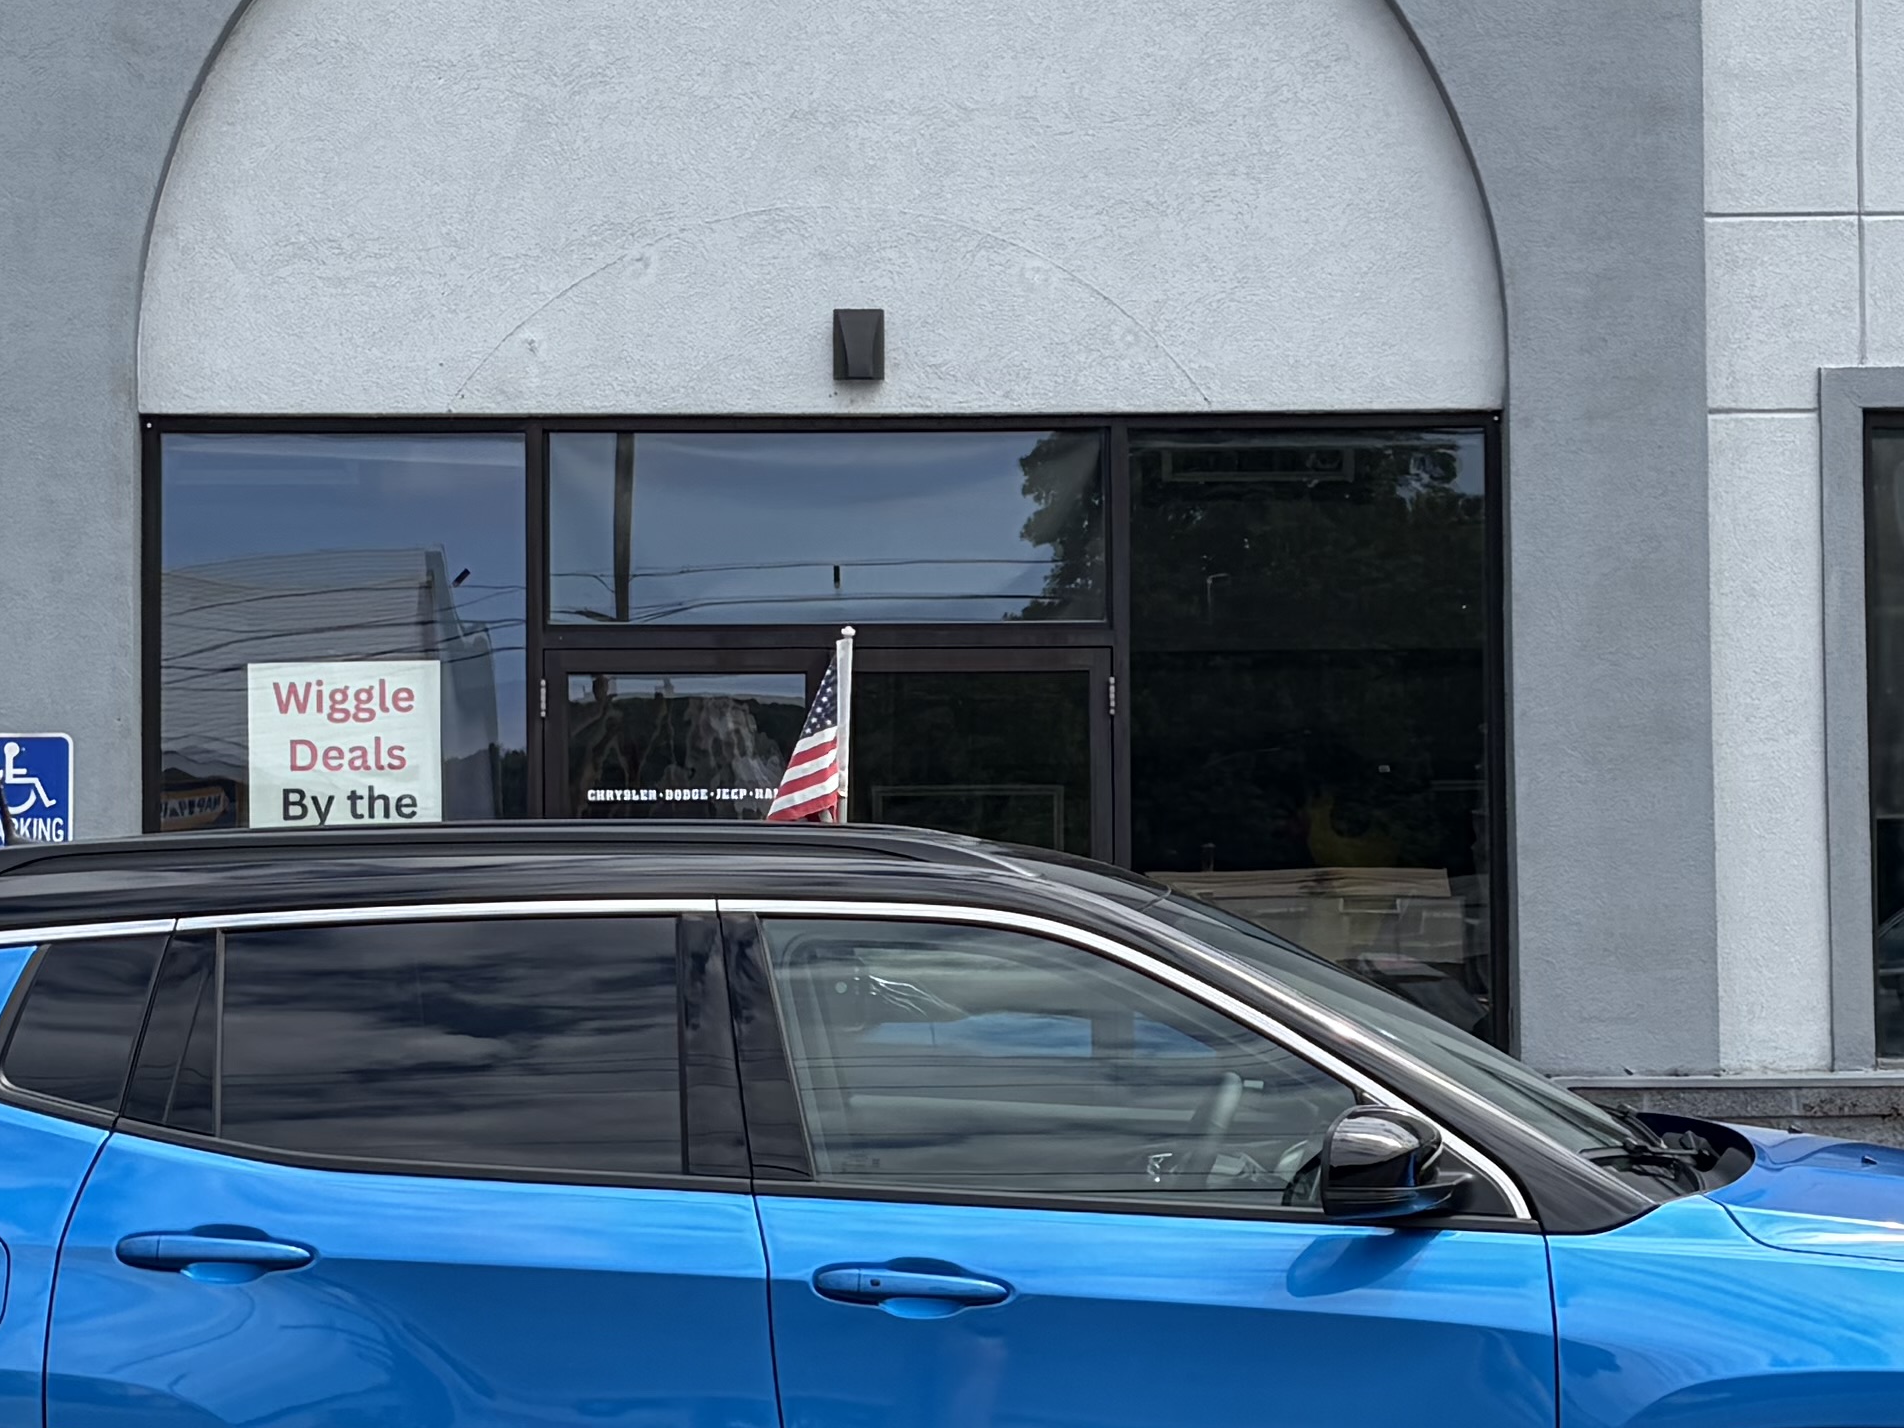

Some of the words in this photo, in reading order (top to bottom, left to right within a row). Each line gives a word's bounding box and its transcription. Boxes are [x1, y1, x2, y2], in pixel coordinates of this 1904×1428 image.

[273, 678, 416, 723] Wiggle
[289, 736, 407, 773] Deals
[283, 788, 336, 825] By
[347, 785, 418, 820] the
